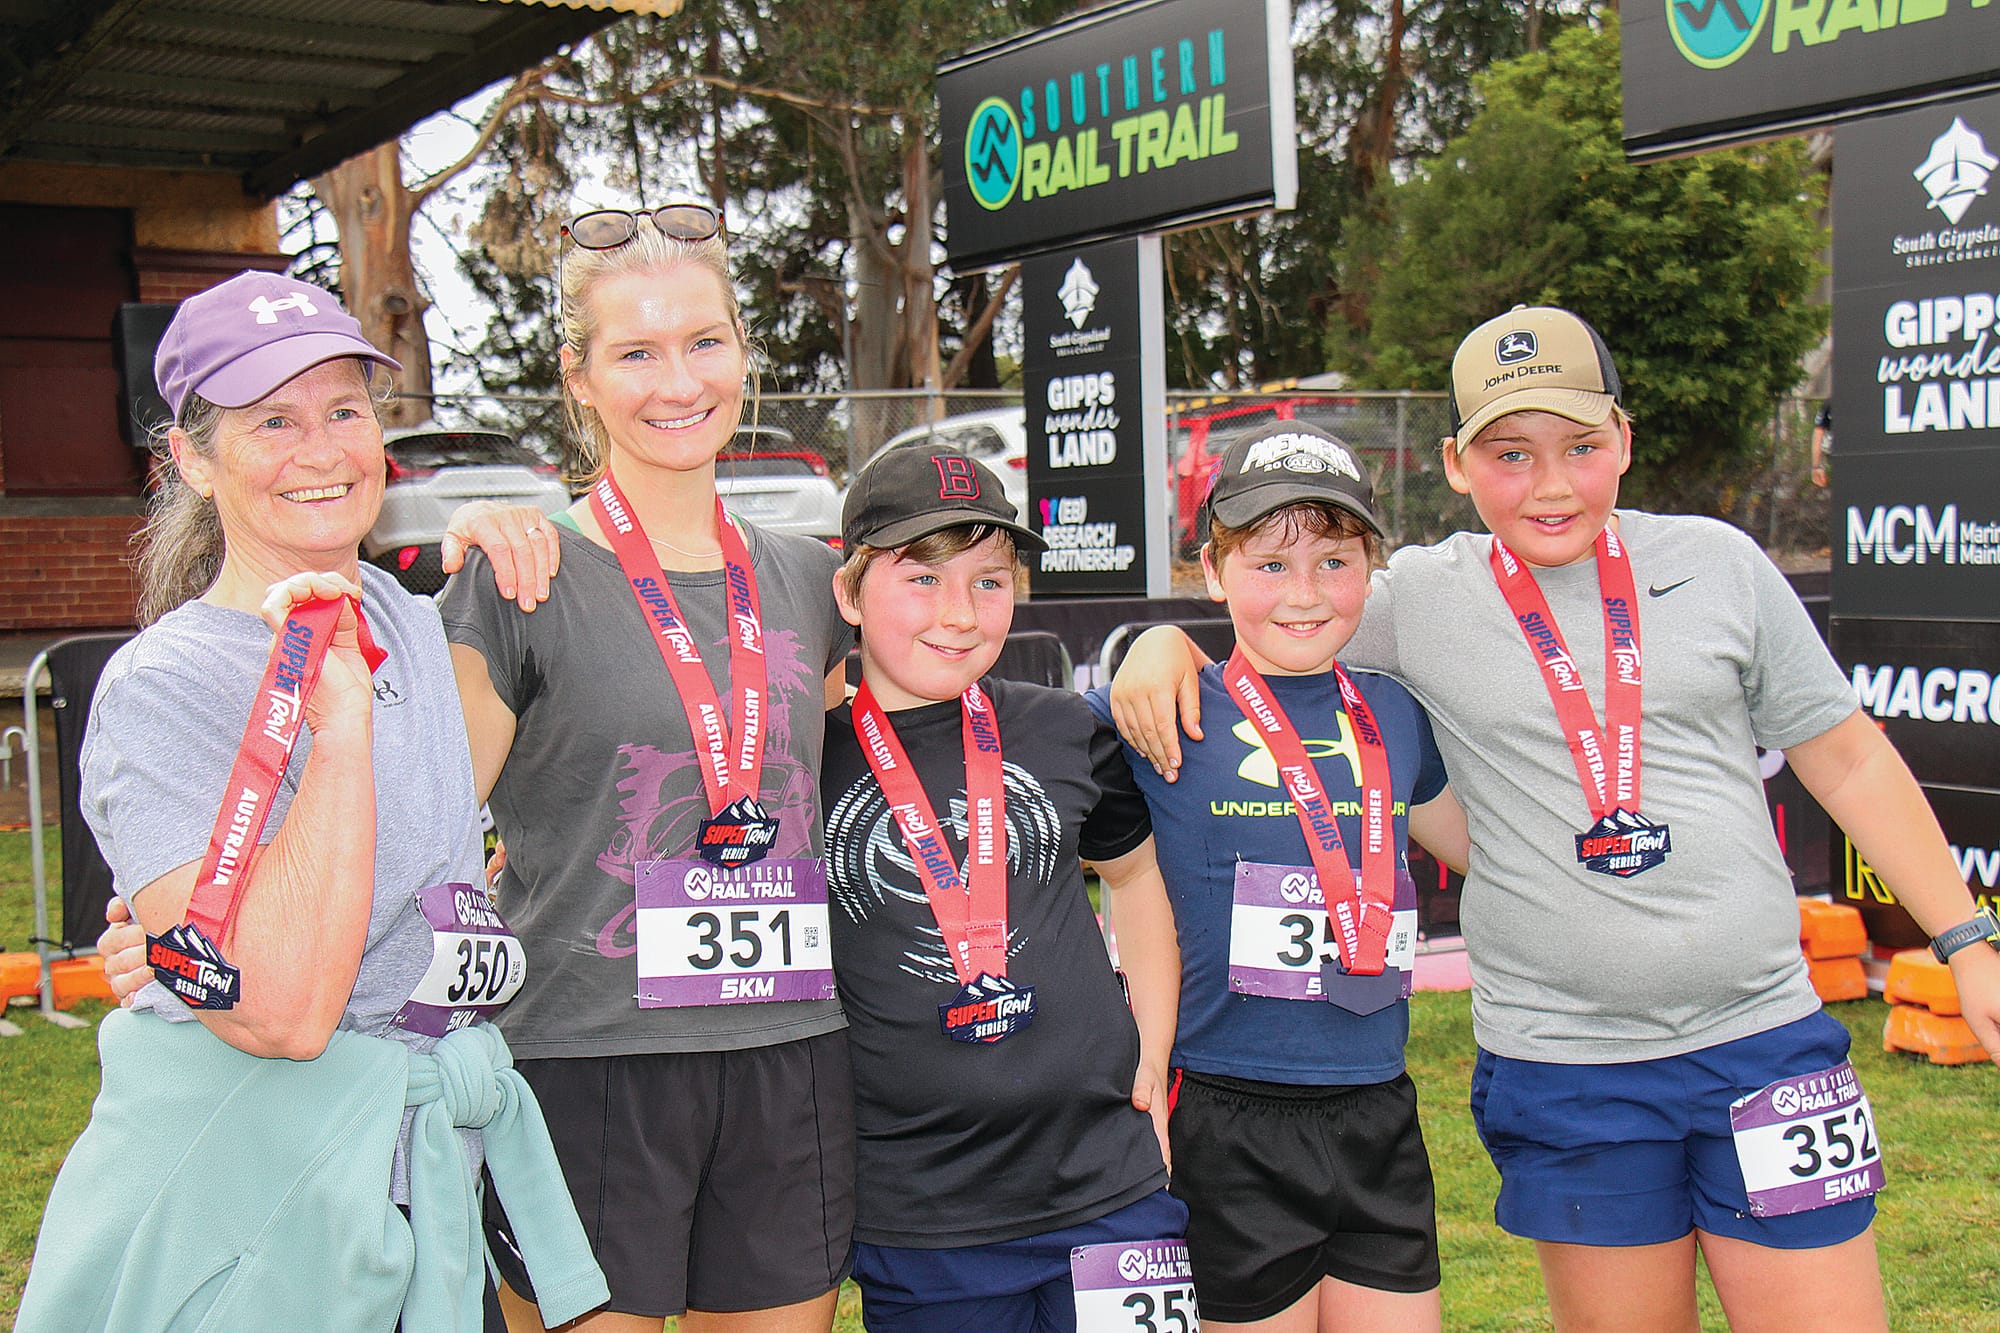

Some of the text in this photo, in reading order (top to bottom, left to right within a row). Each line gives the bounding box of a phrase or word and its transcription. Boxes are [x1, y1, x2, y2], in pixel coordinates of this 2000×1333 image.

[1020, 29, 1225, 139] SOUTHERN
[1022, 93, 1239, 201] RAIL TRAIL
[1892, 231, 1936, 255] South
[1884, 292, 2000, 348] GIPP
[1047, 372, 1116, 410] GIPPS
[1483, 365, 1562, 391] JOHN DEERE
[1045, 401, 1120, 434] wonder
[1049, 429, 1116, 468] LAND
[931, 454, 980, 500] B
[597, 478, 632, 535] FINISHER
[1847, 504, 1957, 565] MCM
[1041, 546, 1135, 572] PARTNERSHIP
[1237, 674, 1282, 733] AUSTRALIA
[699, 703, 728, 788] AUSTRALIA
[739, 687, 759, 770] AUSTRALIA
[861, 710, 897, 772] AUSTRALIA
[1617, 725, 1634, 801] AUSTRALIA
[212, 787, 259, 885] AUSTRALIA
[977, 797, 992, 865] FINISHER
[1369, 789, 1382, 853] FINISHER
[712, 866, 793, 881] SOUTHERN
[721, 848, 750, 860] SERIES
[1609, 855, 1642, 869] SERIES
[711, 882, 796, 899] RAIL TRAIL
[686, 910, 792, 970] 351
[175, 978, 208, 1001] SERIES
[448, 939, 509, 1002] 350
[720, 977, 775, 999] 5KM
[975, 1019, 1009, 1038] SERIES
[1801, 1090, 1838, 1113] RAIL
[1782, 1107, 1876, 1177] 352
[1824, 1170, 1870, 1200] 5KM
[1146, 1262, 1177, 1280] RAIL
